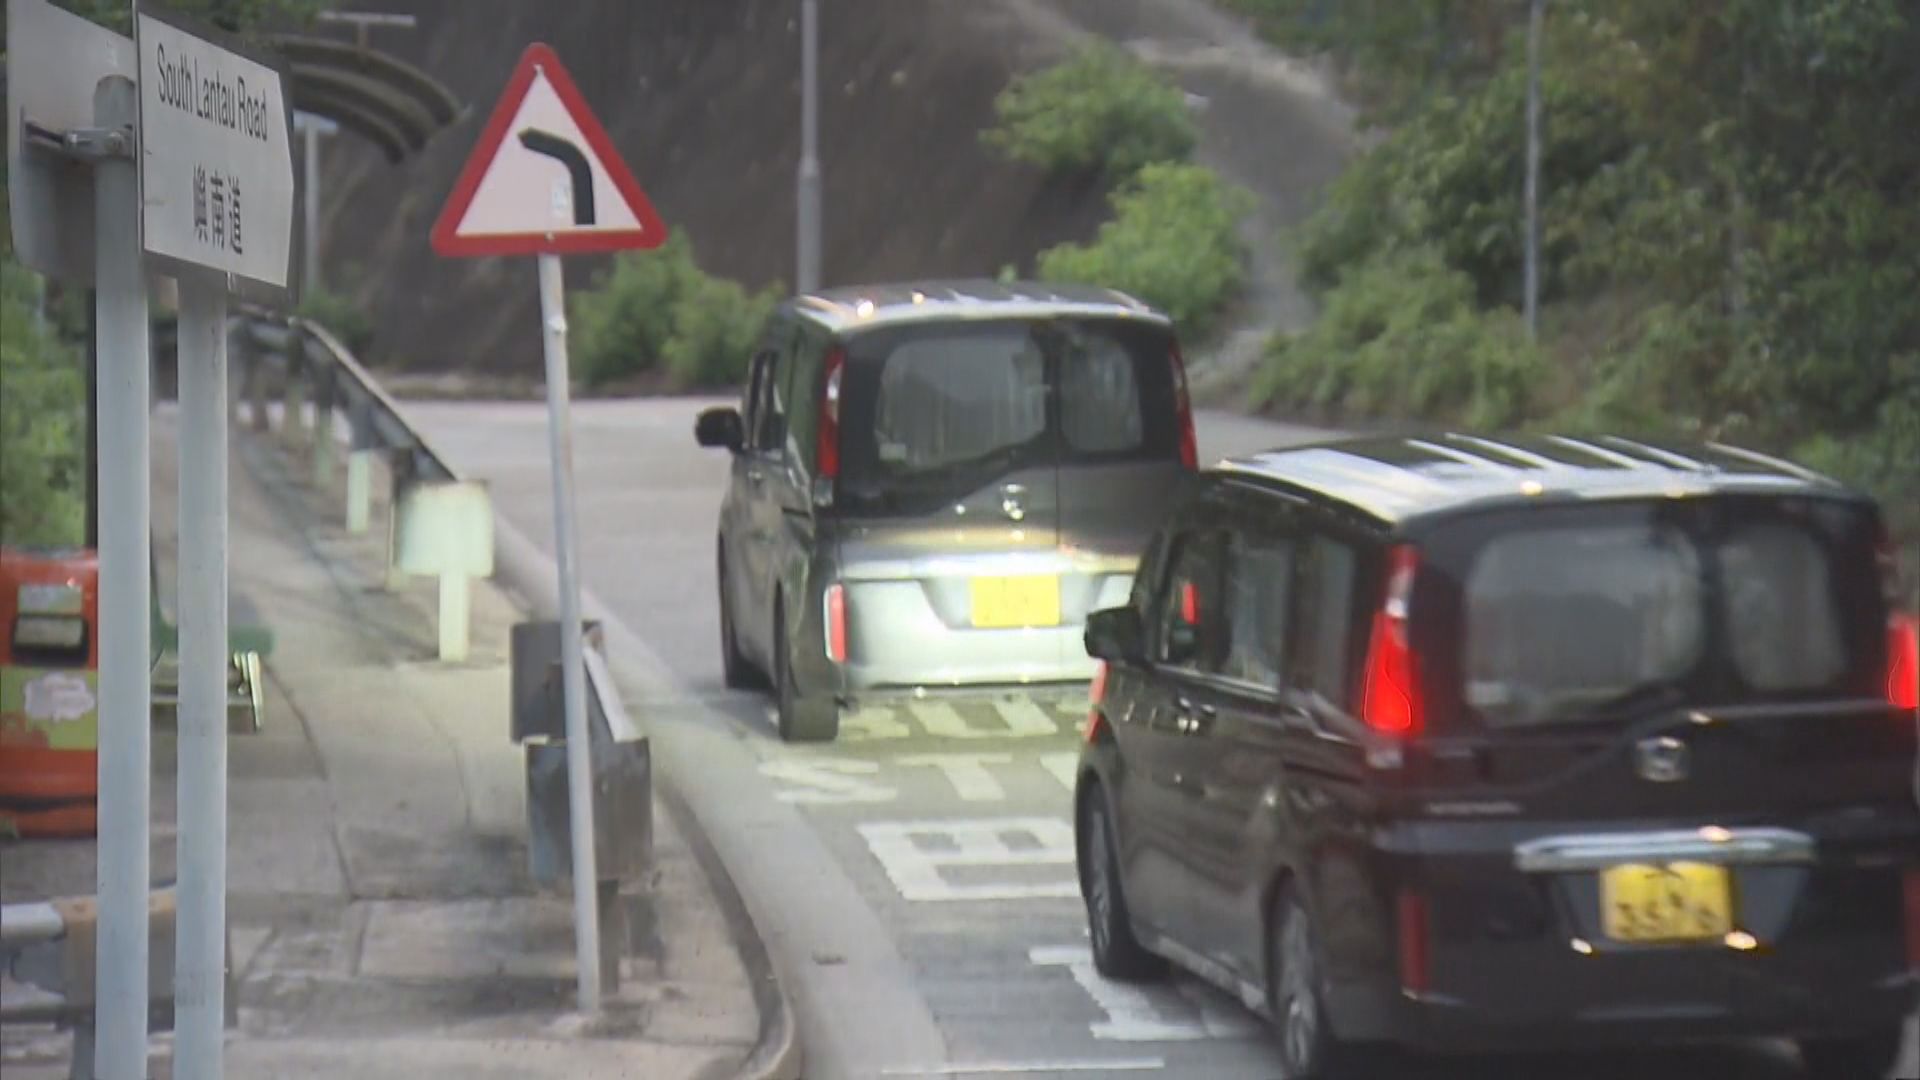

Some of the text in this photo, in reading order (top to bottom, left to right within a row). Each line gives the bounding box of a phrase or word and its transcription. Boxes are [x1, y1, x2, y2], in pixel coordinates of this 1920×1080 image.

[157, 43, 267, 141] South Lantau Road
[193, 164, 243, 254] 嶼南道
